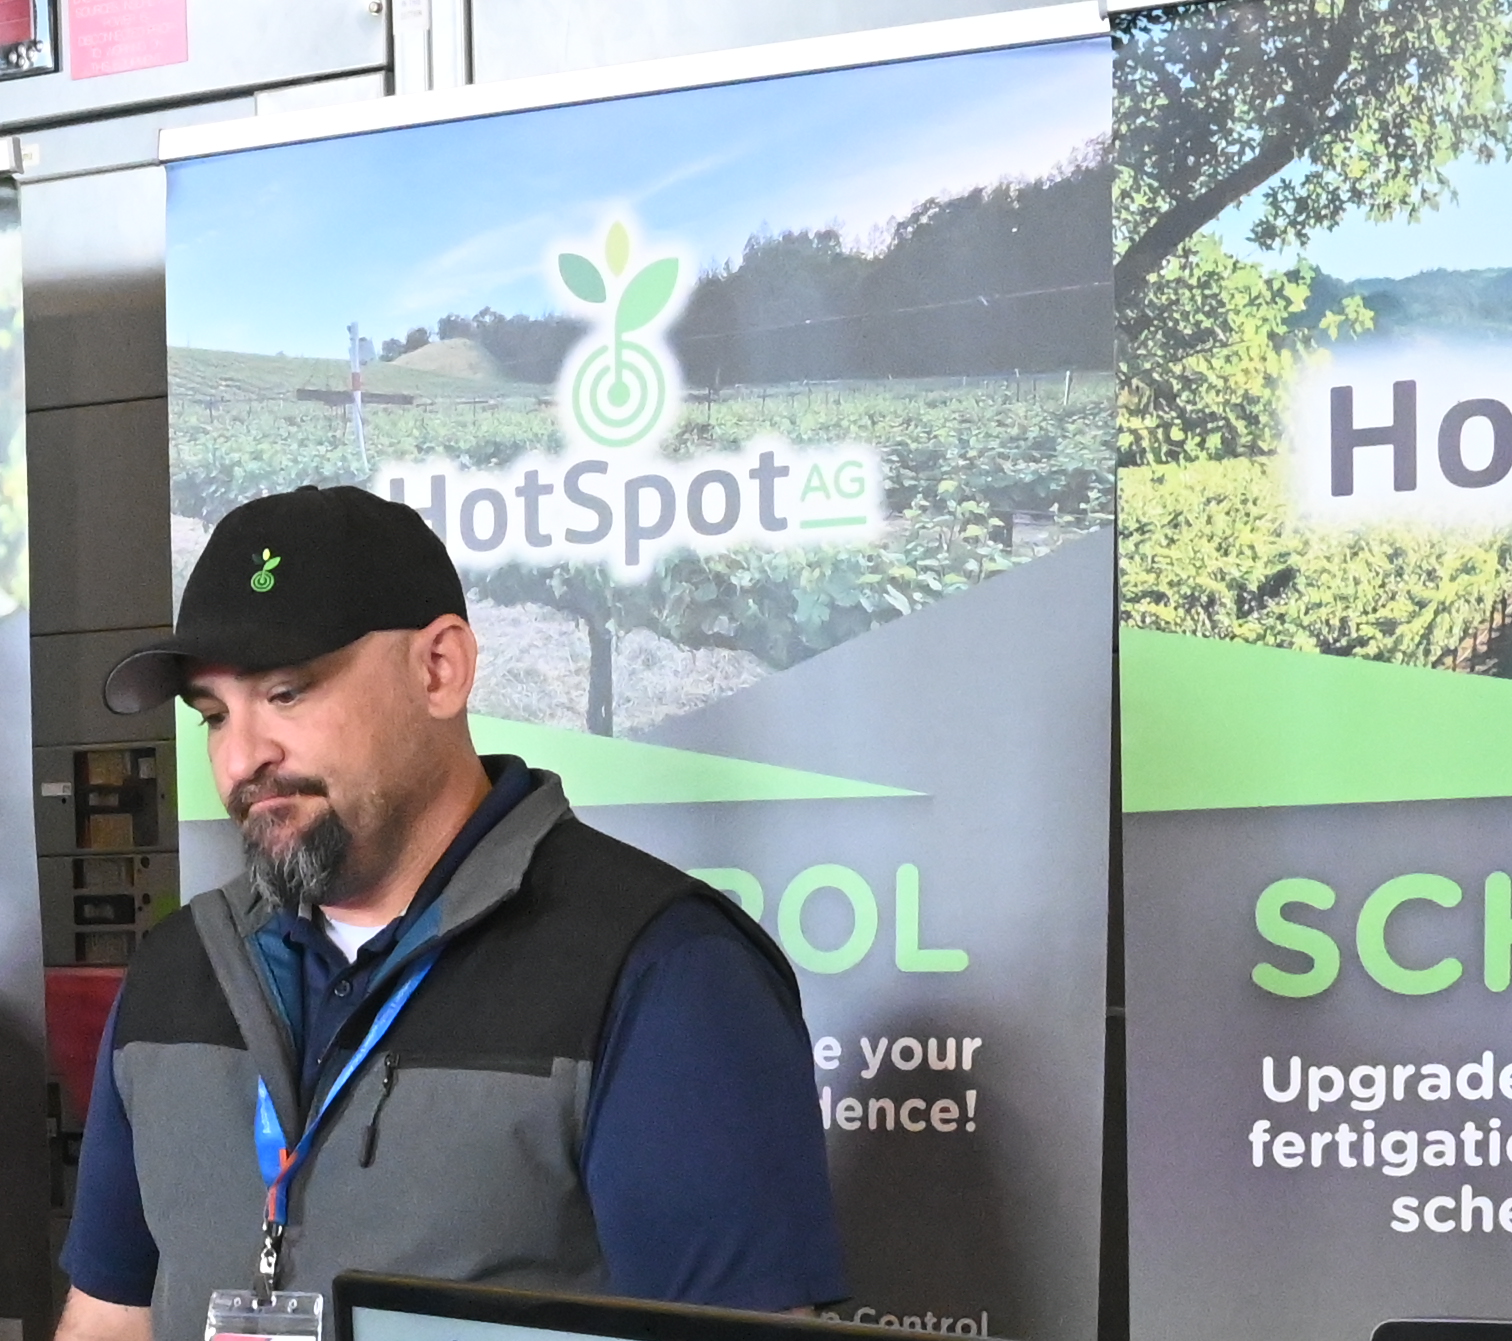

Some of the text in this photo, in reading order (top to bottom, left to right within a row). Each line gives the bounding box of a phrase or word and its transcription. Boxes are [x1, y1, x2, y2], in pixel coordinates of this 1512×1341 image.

[389, 450, 866, 566] HotSpot AG
[860, 1036, 983, 1080] your
